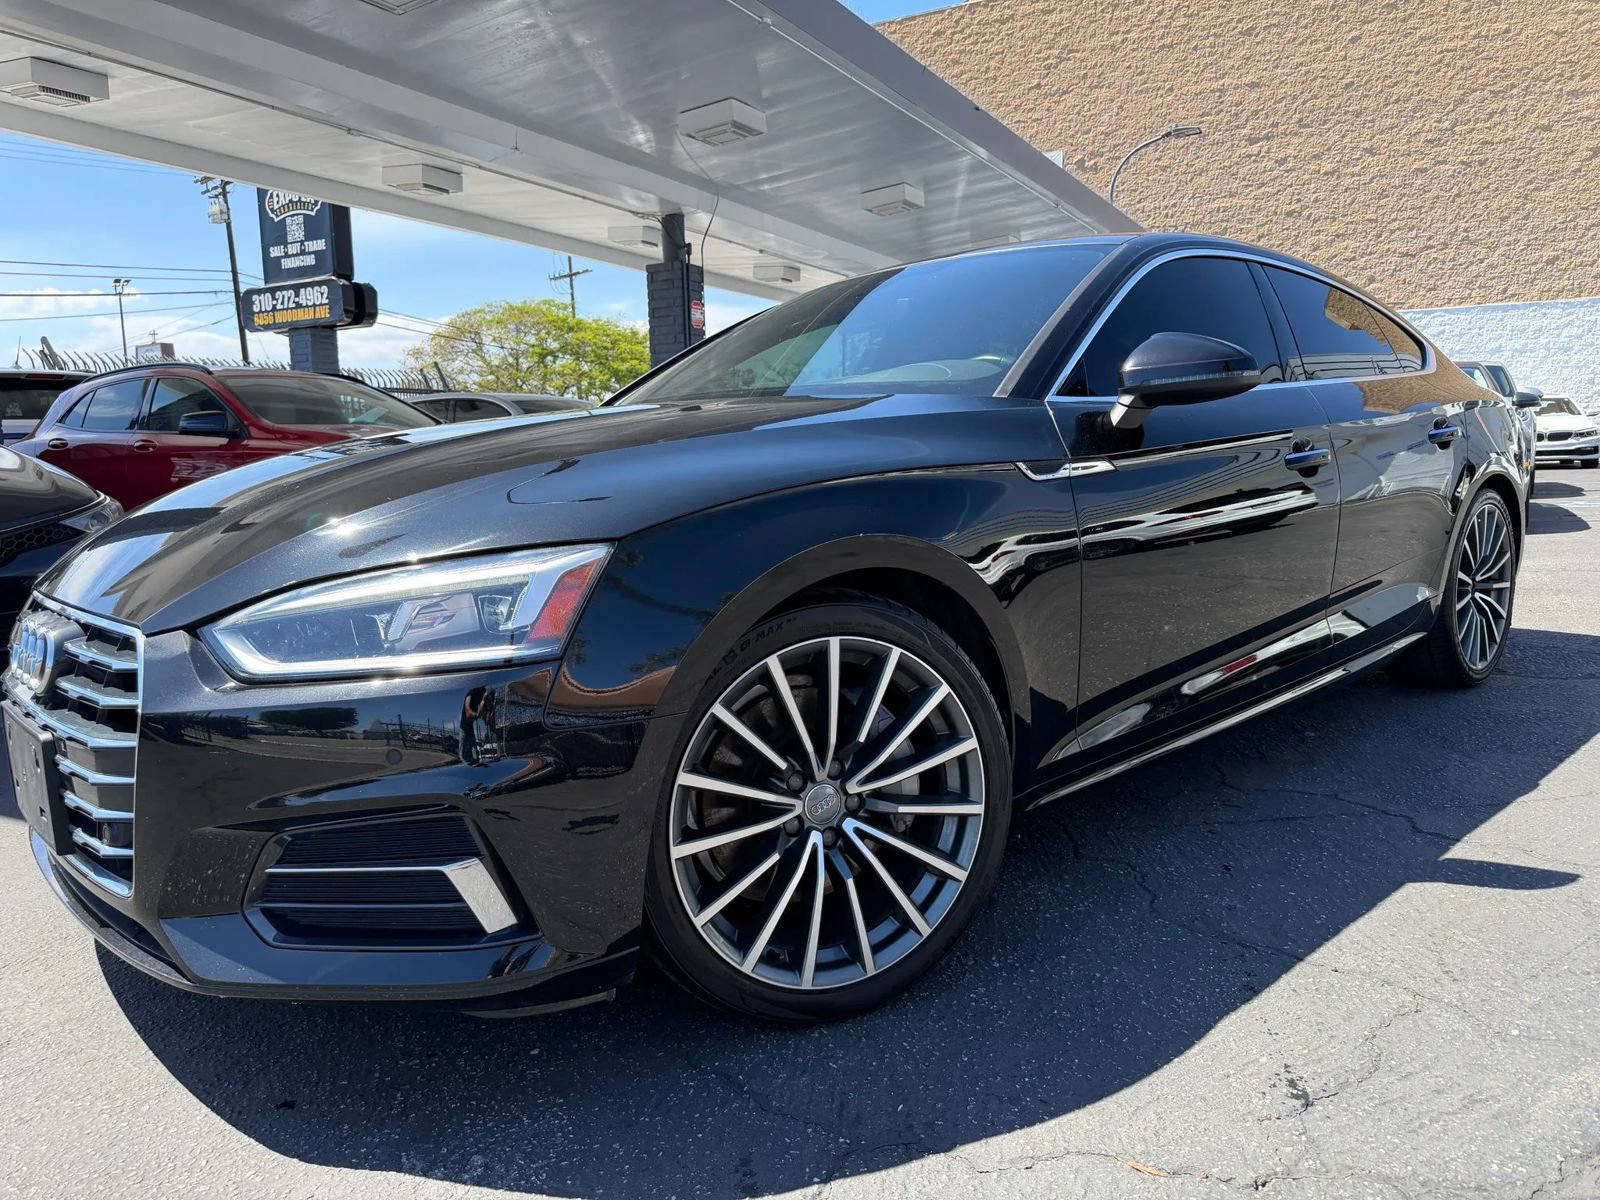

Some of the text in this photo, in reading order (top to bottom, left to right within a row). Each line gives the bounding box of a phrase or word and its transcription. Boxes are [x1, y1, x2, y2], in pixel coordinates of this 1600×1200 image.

[269, 239, 326, 258] SALE BUY TRADE
[281, 254, 316, 269] FINANCING
[252, 285, 329, 312] 310-272-4962
[274, 307, 314, 323] WOODMAN
[315, 305, 330, 319] AVE
